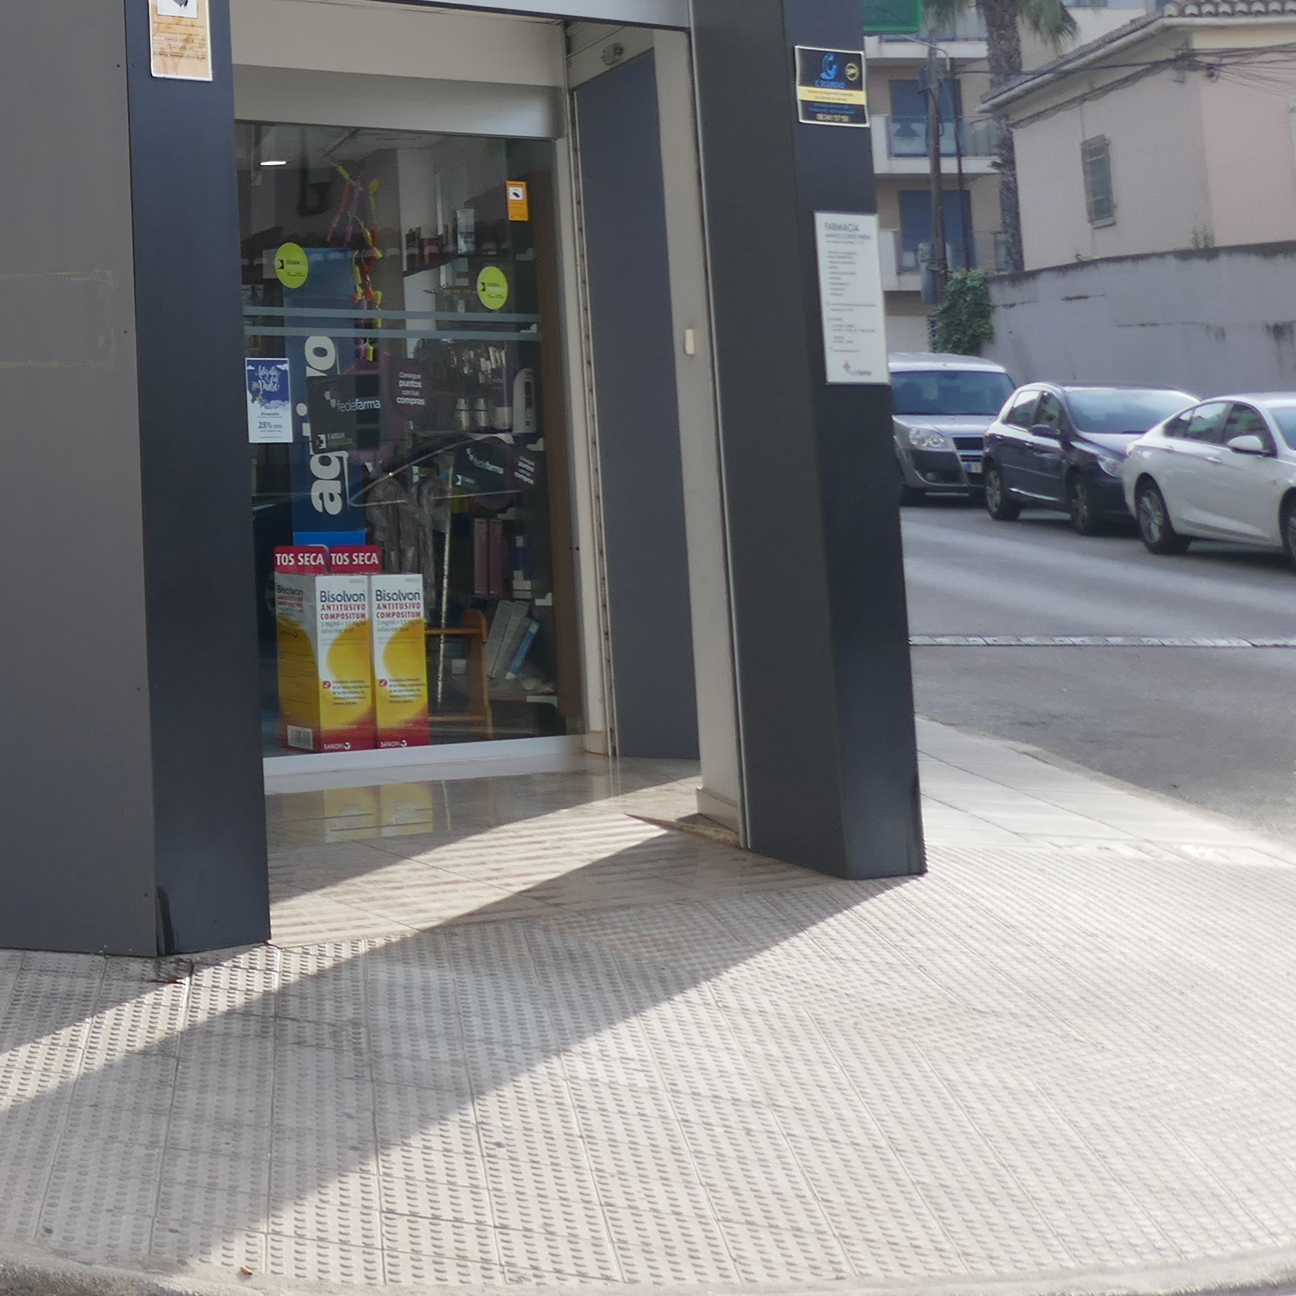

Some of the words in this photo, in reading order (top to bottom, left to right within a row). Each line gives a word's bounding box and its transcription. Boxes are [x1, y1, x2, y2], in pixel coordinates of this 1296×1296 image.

[398, 379, 422, 389] puntos
[336, 398, 381, 412] fedefarma
[396, 396, 425, 405] compras
[276, 554, 296, 566] TOS
[297, 553, 325, 566] SECA
[331, 553, 350, 565] TOS
[352, 552, 379, 565] SECA
[277, 584, 303, 596] Bisolvon
[375, 589, 420, 602] Bisolvon
[320, 590, 366, 603] Bisolvon
[320, 612, 366, 620] COMPOSITUM
[376, 611, 421, 619] COMPOSITUM
